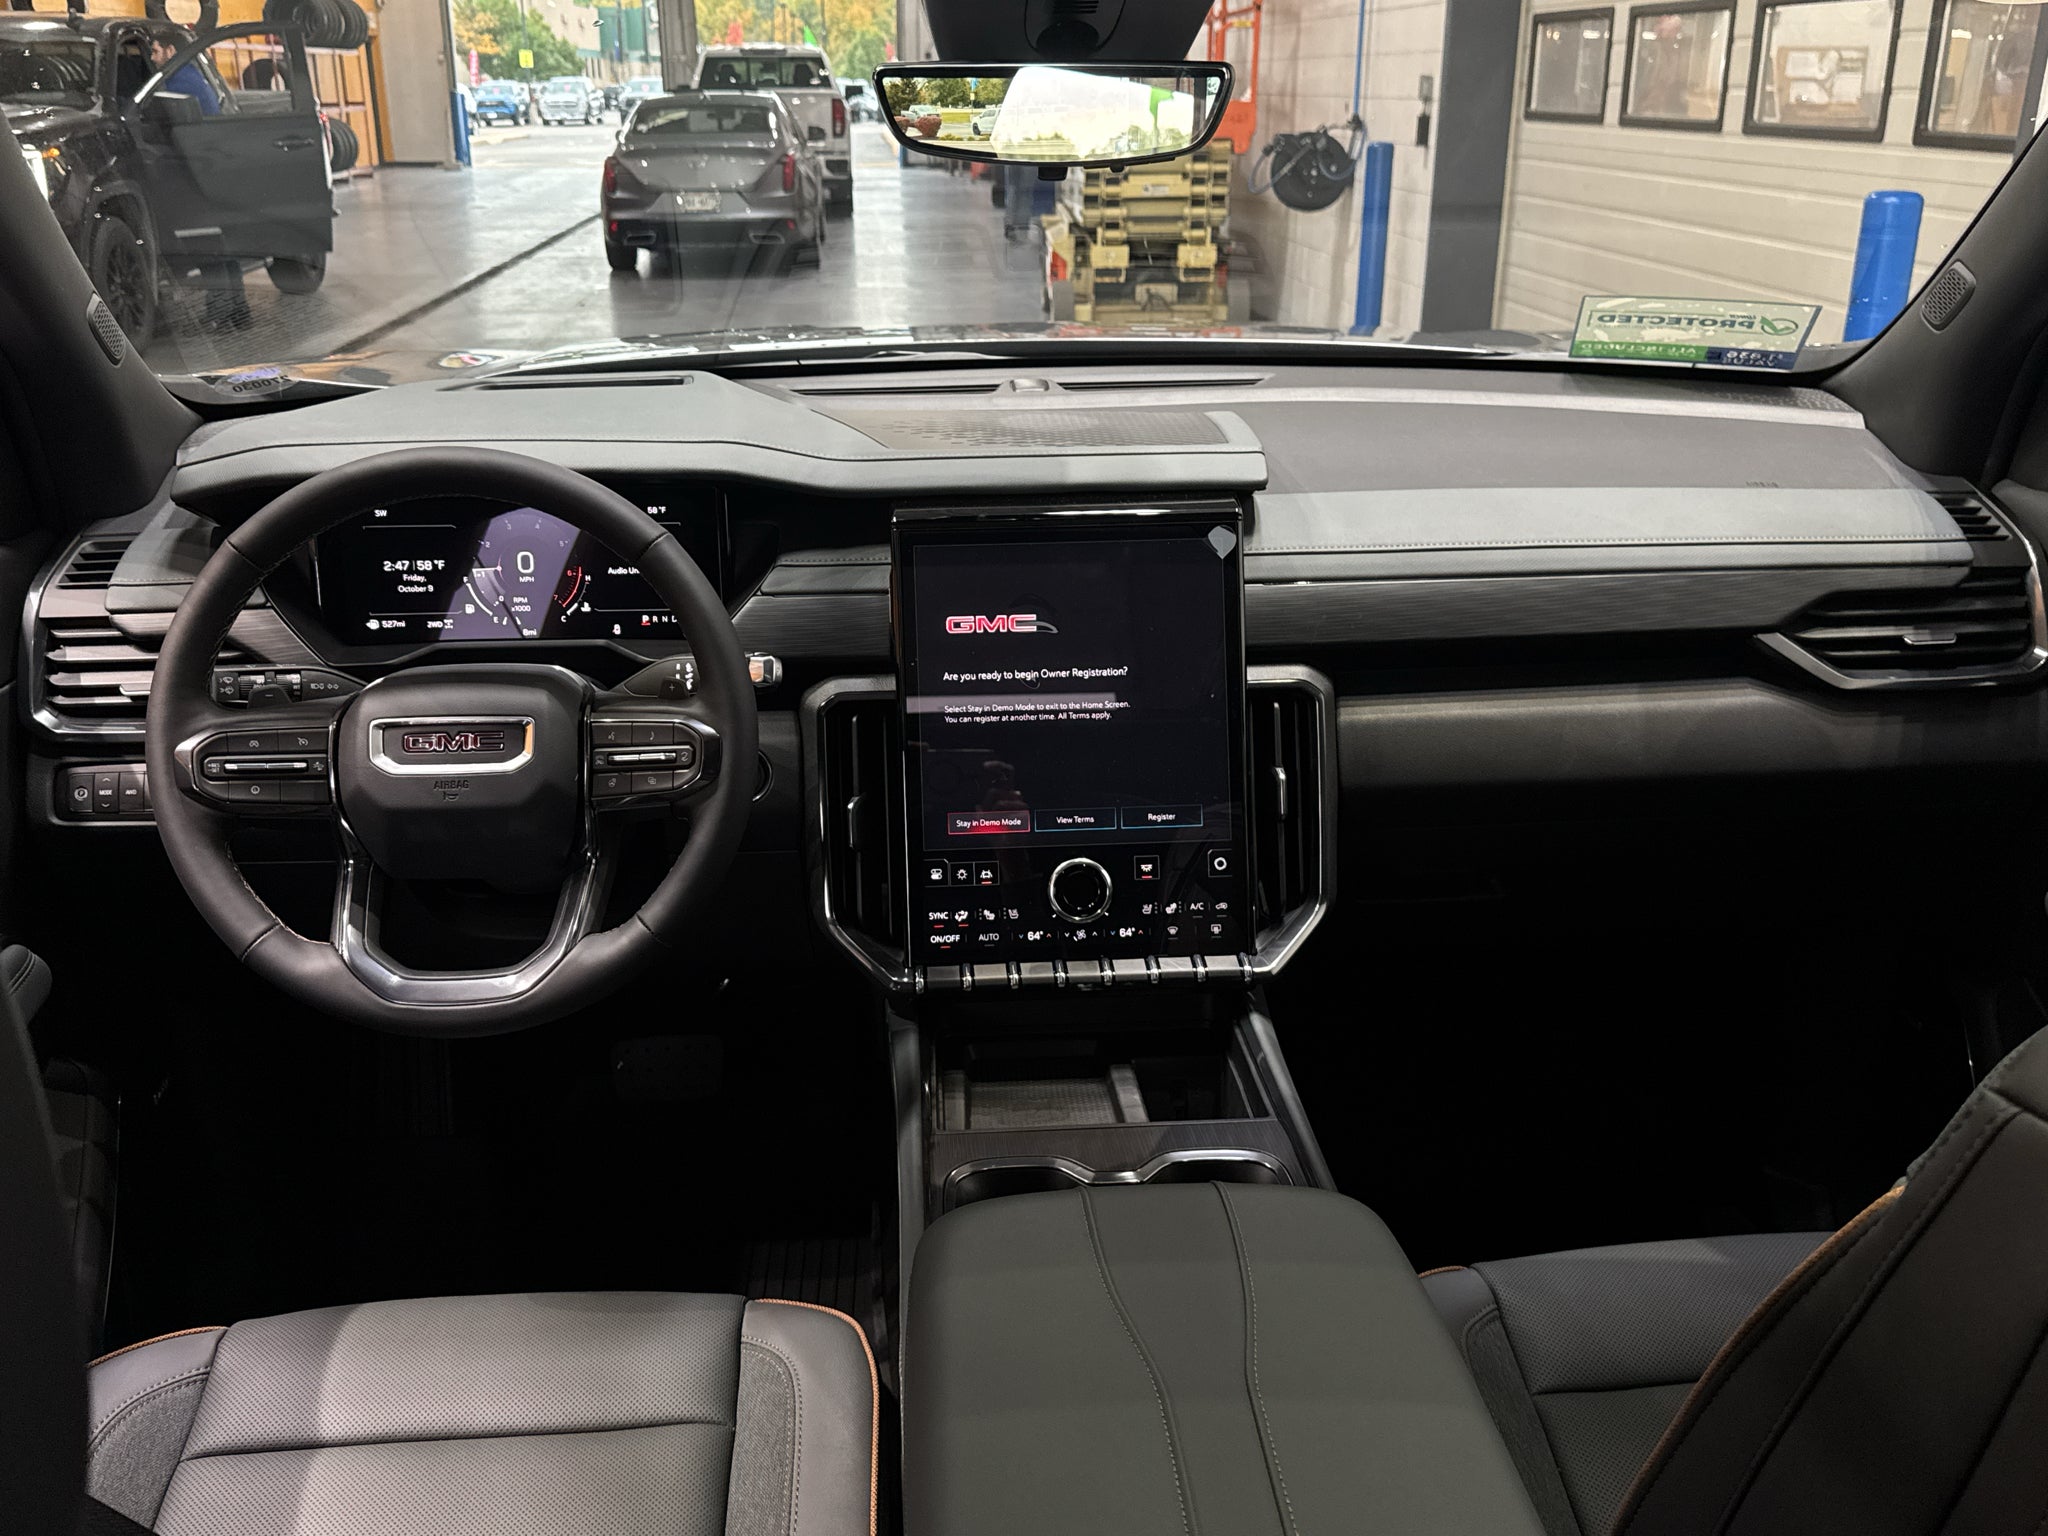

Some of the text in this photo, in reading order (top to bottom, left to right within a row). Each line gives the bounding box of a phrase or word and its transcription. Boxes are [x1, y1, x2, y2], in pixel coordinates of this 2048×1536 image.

[374, 509, 387, 518] SW
[383, 560, 410, 572] 2:47
[416, 560, 433, 571] 58
[516, 551, 535, 574] 0
[607, 566, 629, 575] Audio
[397, 584, 434, 593] October 9
[642, 614, 651, 623] P
[652, 615, 659, 623] R
[661, 615, 669, 623] N
[946, 614, 1037, 633] GMC
[426, 620, 443, 629] 2WD
[943, 666, 1128, 683] Are you ready to begin Owner Registration?
[944, 704, 967, 713] Select
[967, 704, 983, 714] Stay
[992, 703, 1014, 711] Demo
[1015, 702, 1035, 711] Mode
[1036, 702, 1044, 710] to
[1045, 701, 1059, 710] exit
[1059, 701, 1068, 709] to
[1068, 700, 1080, 709] the
[1081, 700, 1104, 709] Home
[1104, 700, 1131, 709] Screen.
[944, 715, 958, 723] You
[973, 714, 1000, 724] register
[1010, 712, 1038, 721] another
[1038, 713, 1057, 721] time.
[1057, 712, 1068, 720] All
[1069, 711, 1090, 719] Terms
[1091, 711, 1113, 721] apply.
[404, 732, 504, 752] GMC
[433, 779, 470, 789] AIRBAG
[956, 816, 1022, 829] Stay in Demo Mode
[1056, 814, 1095, 824] View Terms
[1147, 812, 1177, 823] Register
[1190, 902, 1204, 911] A/C
[928, 911, 949, 920] SYNC
[930, 934, 961, 943] ON/OFF
[978, 933, 1000, 941] AUTO
